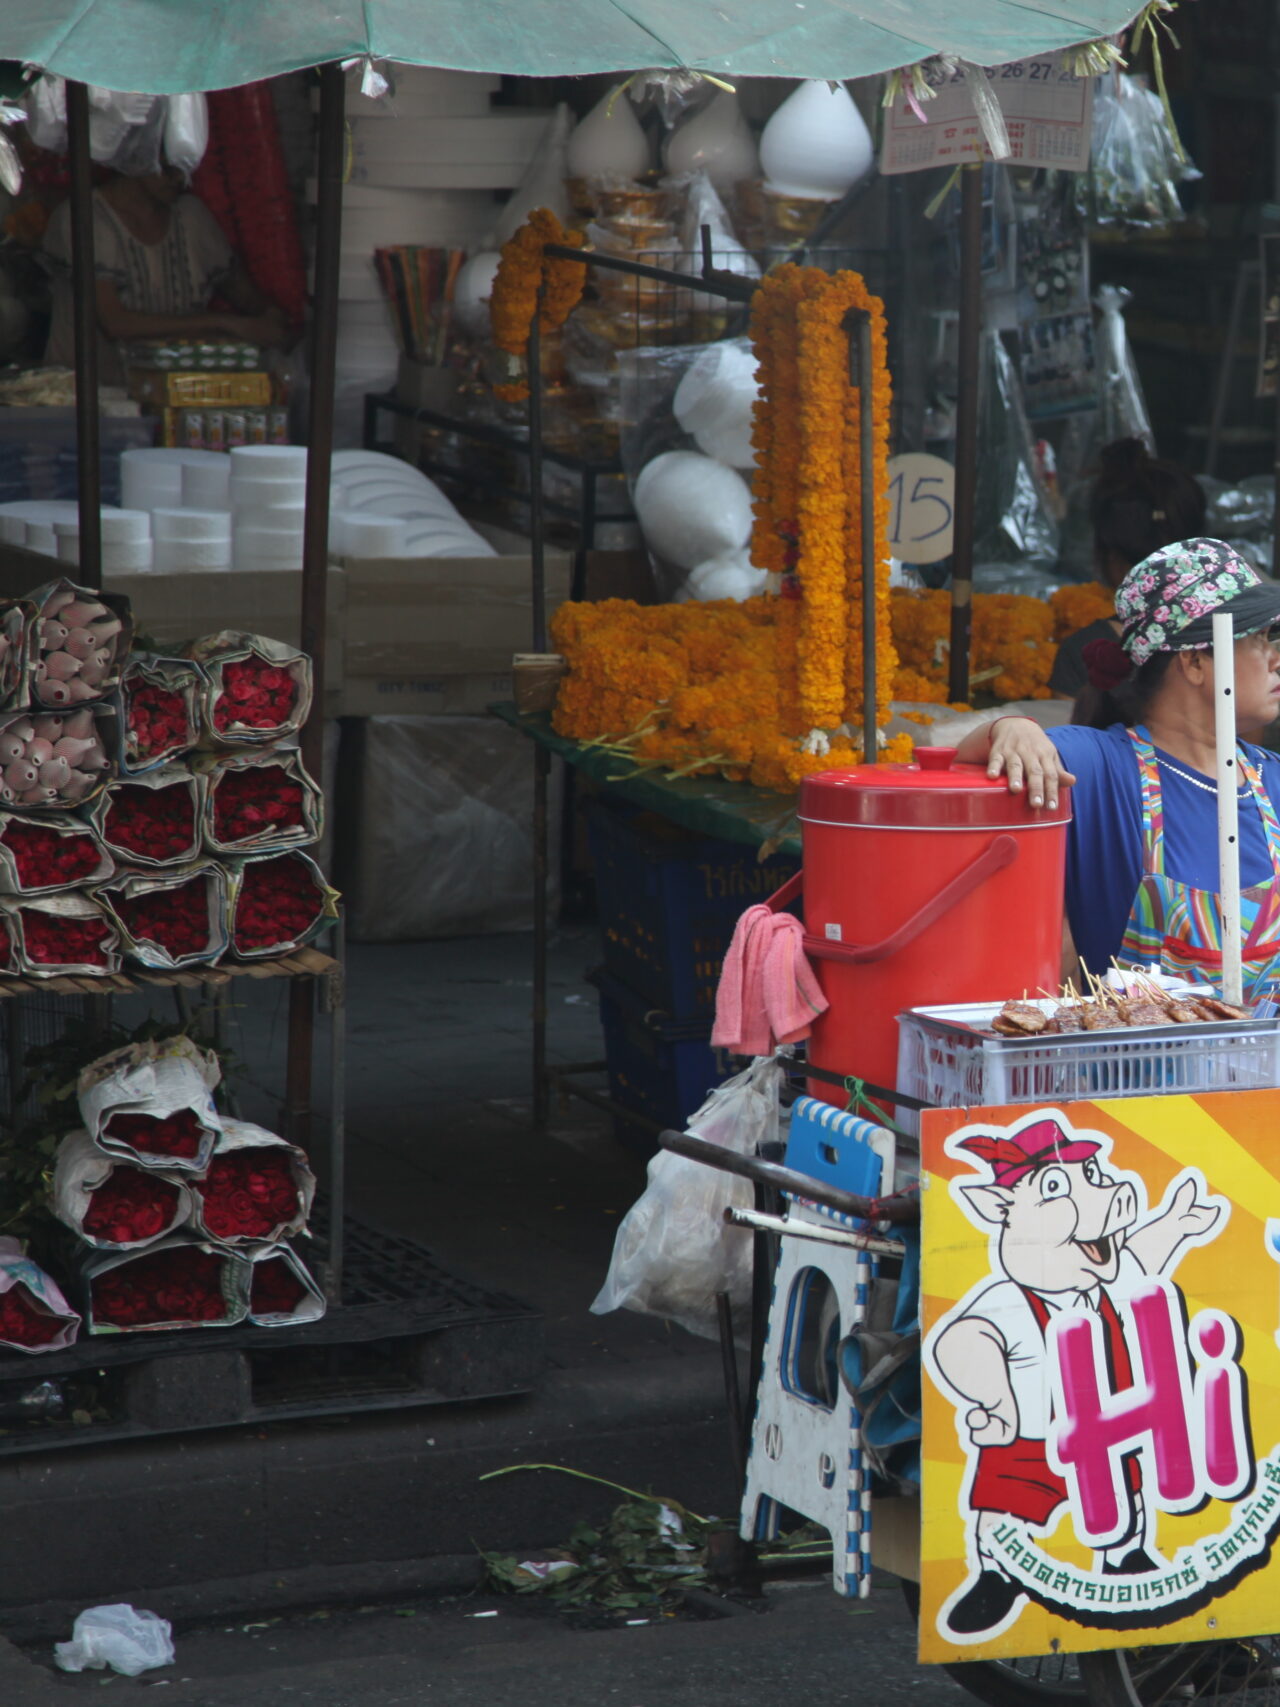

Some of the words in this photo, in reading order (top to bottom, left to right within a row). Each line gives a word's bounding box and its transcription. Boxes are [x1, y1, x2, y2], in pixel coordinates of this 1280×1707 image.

[1002, 63, 1022, 78] 26
[1030, 62, 1052, 81] 27
[888, 471, 952, 543] 15
[1056, 1283, 1240, 1536] Hi
[992, 1522, 1200, 1604] ปลอดสารบอแรกซ์
